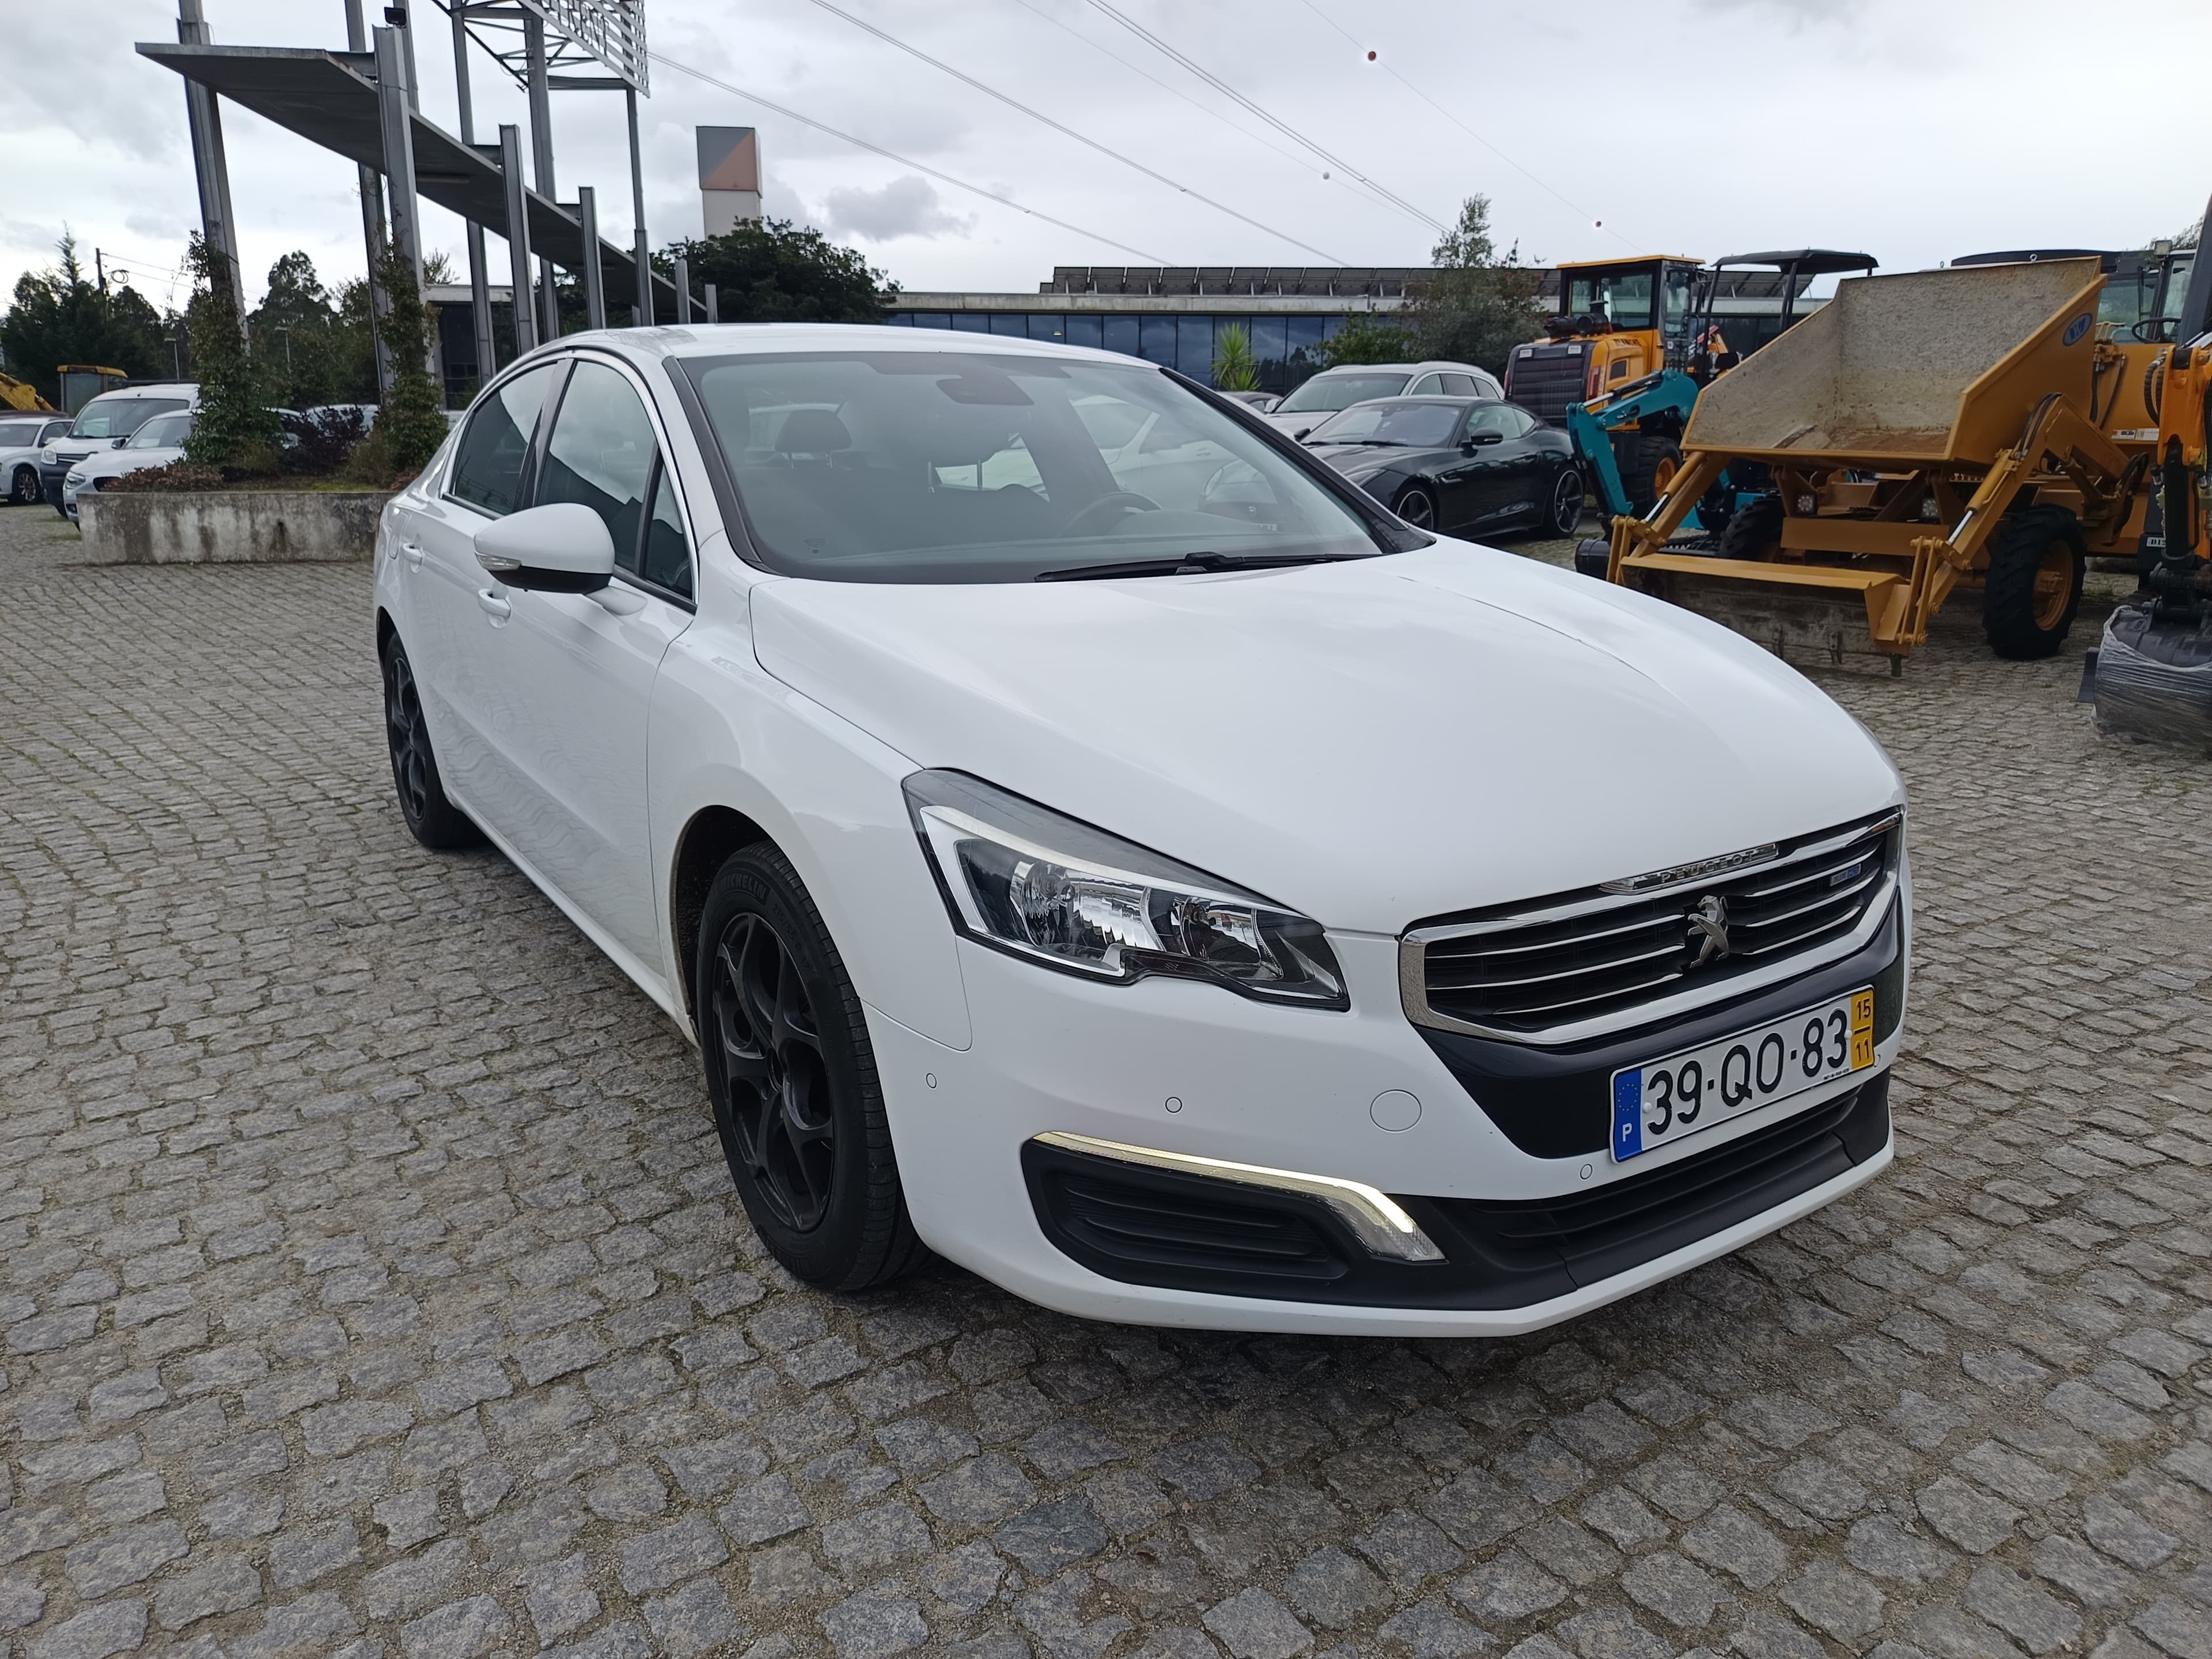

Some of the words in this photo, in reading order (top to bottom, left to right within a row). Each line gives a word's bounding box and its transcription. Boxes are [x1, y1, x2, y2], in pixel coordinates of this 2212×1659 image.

[1660, 850, 1755, 883] PEUGEOT
[720, 873, 767, 900] MICHELIN
[1857, 997, 1870, 1022] 15
[1856, 1039, 1870, 1062] 11
[1622, 1123, 1633, 1142] P
